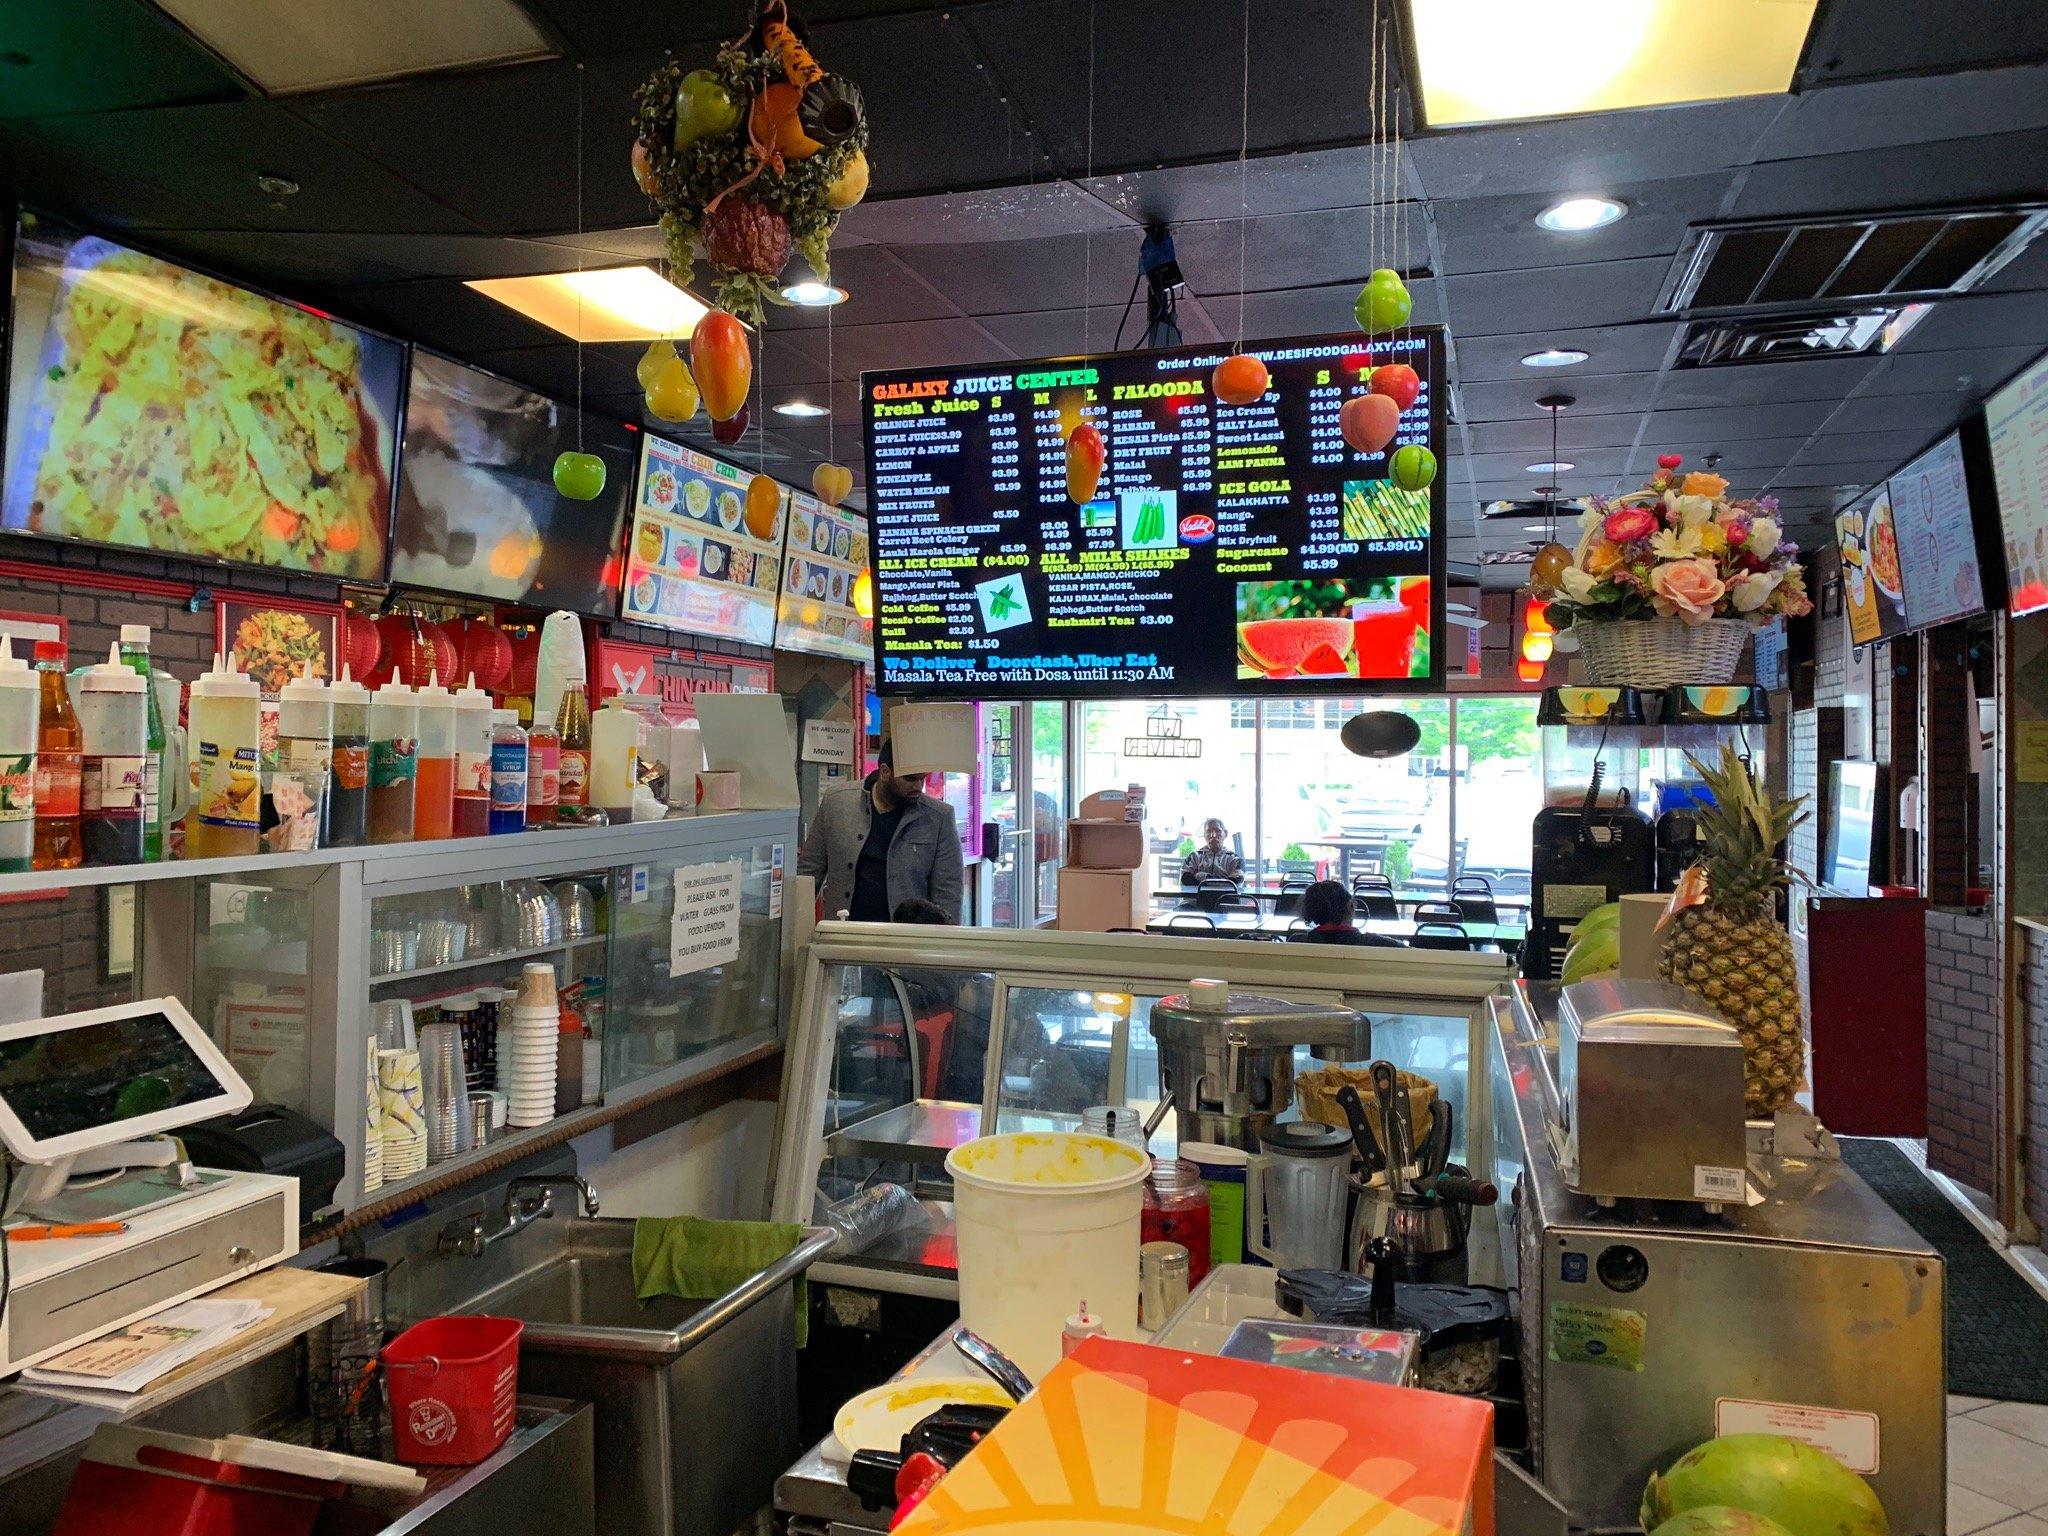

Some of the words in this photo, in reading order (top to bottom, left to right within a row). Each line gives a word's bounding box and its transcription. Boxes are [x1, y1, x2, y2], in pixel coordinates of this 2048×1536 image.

[1158, 358, 1190, 370] Order
[1193, 356, 1230, 367] Onlin
[1240, 338, 1426, 364] WW.DESIFOODGALAXY.COM
[873, 380, 949, 400] GALAXY
[953, 376, 1012, 394] JUICE
[1016, 368, 1099, 390] CENTER
[1316, 370, 1331, 385] S
[1113, 380, 1205, 401] FALOODA
[874, 402, 924, 417] Fresh
[932, 398, 980, 413] Juice
[991, 396, 1002, 408] S
[1034, 393, 1050, 405] M
[1086, 389, 1098, 401] L
[1113, 410, 1142, 420] ROSE
[1178, 405, 1207, 415] $5.99
[1216, 408, 1235, 418] Ice
[1236, 406, 1275, 417] Cream
[874, 419, 915, 430] ORANGE
[917, 418, 946, 428] JUICE
[1113, 421, 1156, 433] RABADI
[1181, 418, 1210, 428] $5.99
[1217, 421, 1246, 431] SALT
[1248, 418, 1279, 429] Lassi
[875, 434, 906, 444] APPLE
[1113, 434, 1151, 445] KESAR
[1152, 432, 1181, 443] Pista
[1182, 430, 1211, 441] $5.99
[1217, 434, 1252, 445] Sweet
[1252, 430, 1285, 441] Lassi
[876, 446, 916, 457] CARROT
[918, 446, 926, 455] &
[928, 444, 960, 454] APPLE
[1114, 448, 1136, 458] DRY
[1138, 446, 1173, 456] FRUIT
[1182, 444, 1211, 454] $5.99
[1217, 444, 1278, 457] Lemonade
[876, 461, 912, 471] LEMON
[1114, 460, 1146, 471] Malai
[1182, 456, 1211, 467] $5.99
[1217, 460, 1244, 470] AAM
[1246, 457, 1286, 468] PANNA
[876, 474, 931, 484] PINEAPPLE
[1114, 474, 1152, 484] Mango
[877, 488, 913, 498] WATER
[914, 486, 950, 496] MELON
[1220, 482, 1246, 495] ICE
[1248, 480, 1292, 493] GOLA
[878, 502, 898, 511] MIX
[900, 500, 935, 510] FRUITS
[1218, 496, 1289, 508] KALAKHATTA
[877, 516, 910, 525] GRAPE
[911, 514, 940, 523] JUICE
[993, 510, 1020, 519] $5.50
[1218, 512, 1255, 521] Mango.
[878, 528, 920, 537] BANANA
[920, 526, 965, 535] SPINACH
[966, 524, 1000, 534] GREEN
[1218, 524, 1247, 533] ROSE
[878, 536, 911, 546] Carrot
[912, 536, 935, 544] Beet
[936, 535, 969, 545] Celery
[1218, 536, 1237, 546] Mix
[1238, 534, 1278, 546] Dryfruit
[879, 548, 908, 557] Lauki
[945, 546, 980, 557] Ginger
[1088, 540, 1115, 550] $7.99
[1217, 547, 1289, 560] Sugarcane
[1300, 542, 1360, 555] $4.99(M)
[1368, 540, 1424, 552] $5.99(L)
[879, 560, 903, 570] ALL
[904, 558, 928, 569] ICE
[930, 556, 978, 568] CREAM
[983, 555, 1030, 568] ($4.00)
[1040, 554, 1070, 565] ALL
[1079, 551, 1123, 564] MILK
[1126, 548, 1190, 562] SHAKES
[1042, 564, 1083, 573] S($3.99)
[1085, 562, 1130, 572] M($4.99)
[1132, 560, 1175, 571] L($5.99)
[1217, 562, 1273, 574] Coconut
[937, 581, 960, 589] Pista
[1049, 584, 1079, 592] KESAR
[1050, 595, 1073, 603] KAJU
[1129, 592, 1173, 601] chocolate
[882, 605, 904, 614] Cold
[908, 604, 940, 613] Coffee
[1114, 604, 1145, 613] Scotch
[914, 616, 947, 624] Coffee
[948, 615, 974, 624] $2.00
[1048, 616, 1107, 627] Kashmiri
[1108, 616, 1135, 626] Tea:
[1140, 615, 1174, 625] $3.00
[949, 626, 975, 635] $2.50
[885, 640, 933, 651] Masala
[934, 639, 963, 650] Tea:
[968, 638, 1000, 650] $1.50
[884, 656, 910, 670] We
[912, 656, 976, 670] Deliver
[1126, 653, 1158, 667] Eat
[884, 670, 934, 683] Masala
[936, 670, 963, 682] Tea
[965, 669, 998, 682] Free
[1000, 668, 1032, 681] with
[1034, 668, 1071, 681] Dosa
[1073, 668, 1109, 681] until
[1112, 669, 1145, 682] 11:30
[1147, 666, 1175, 680] AM
[813, 748, 845, 757] MONDAY
[687, 893, 705, 903] PLEASE
[706, 890, 716, 900] ASK
[719, 888, 730, 898] FOR
[680, 910, 699, 922] WATER
[704, 906, 719, 918] GLASS
[720, 902, 735, 914] FROM
[688, 925, 704, 937] FOOD
[704, 921, 726, 933] VENDOR
[678, 948, 690, 957] YOU
[690, 944, 701, 955] BUY
[702, 940, 717, 951] FOOD
[718, 936, 733, 947] FROM
